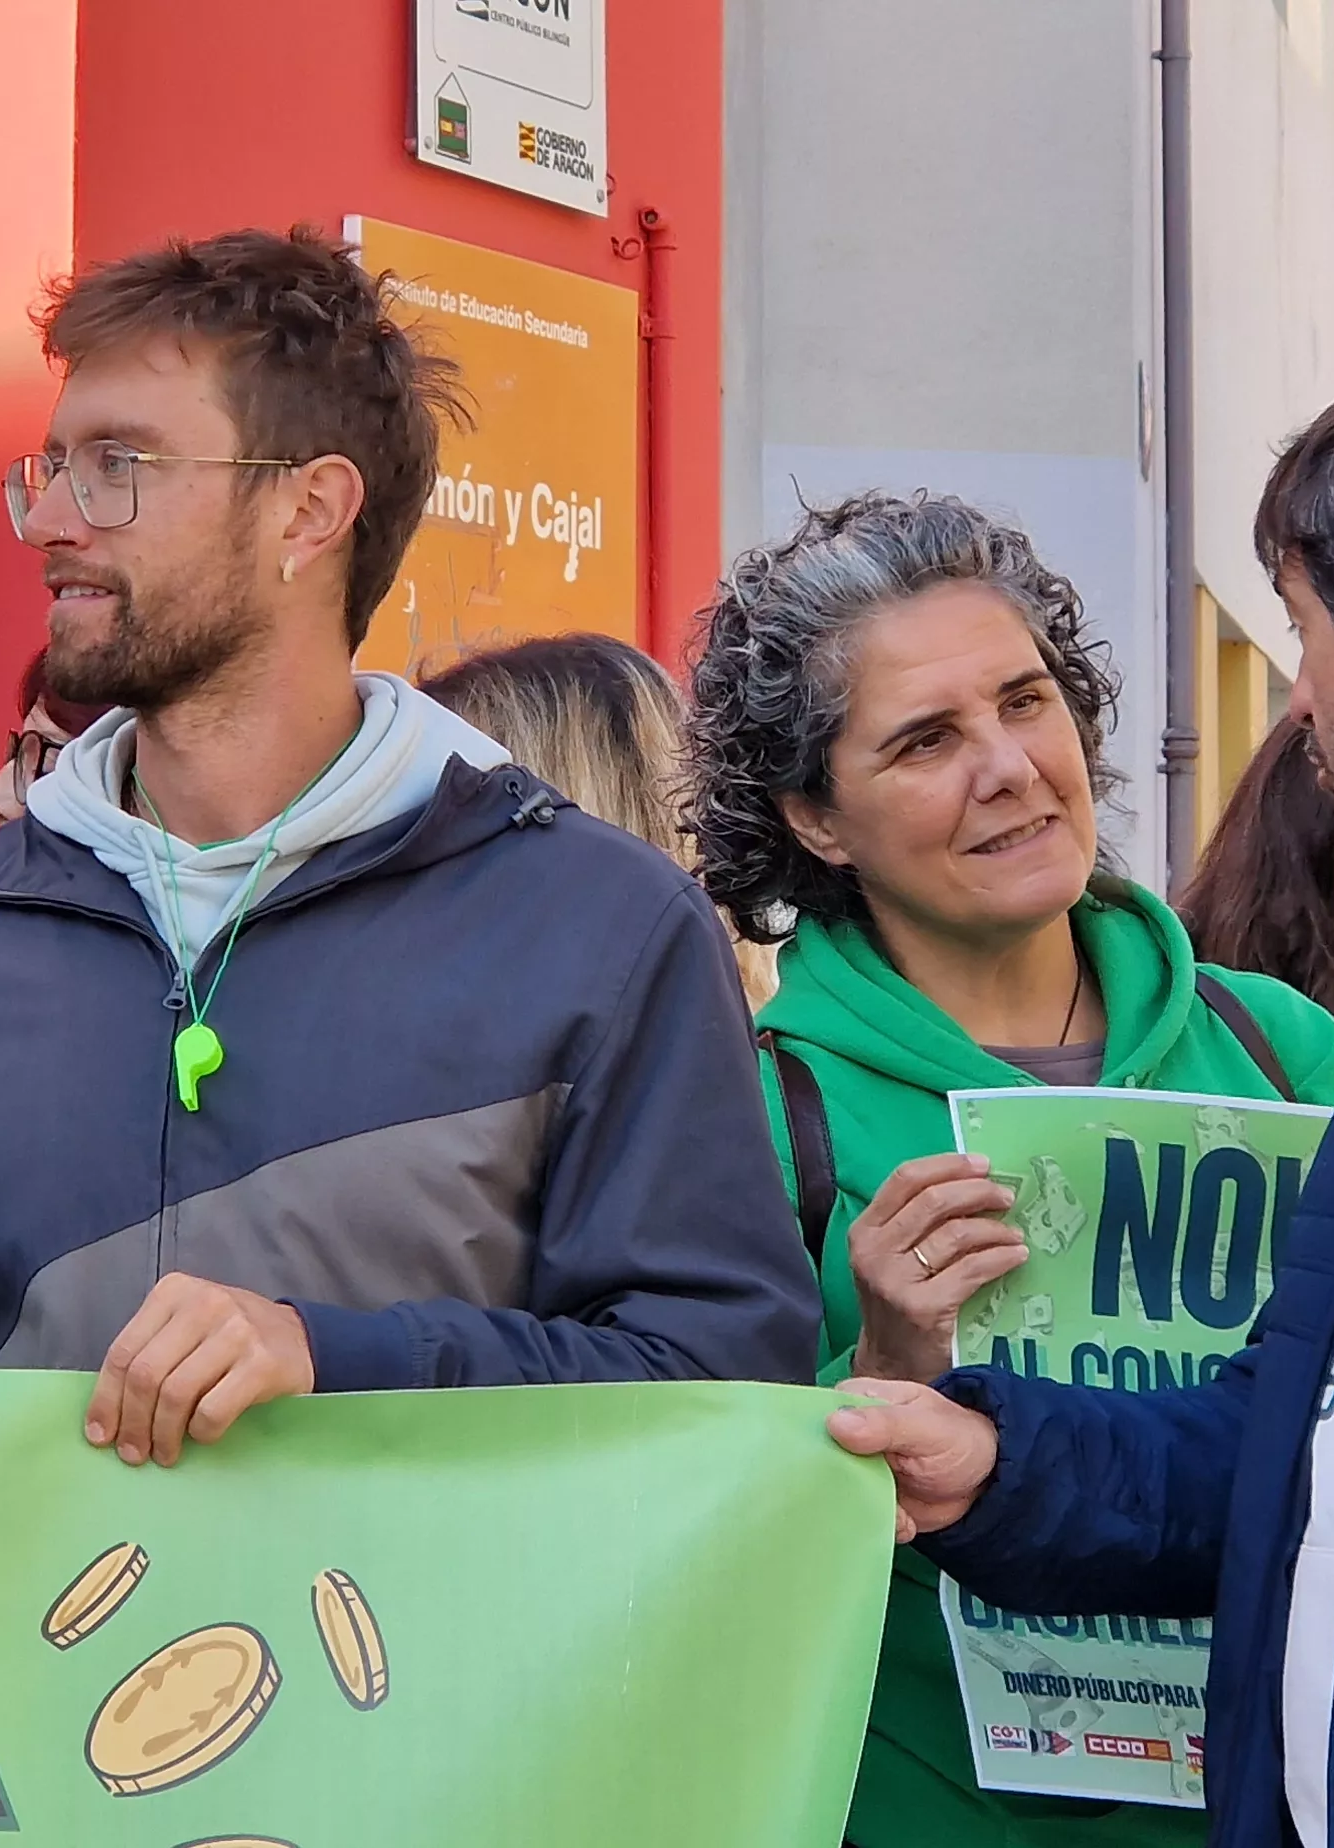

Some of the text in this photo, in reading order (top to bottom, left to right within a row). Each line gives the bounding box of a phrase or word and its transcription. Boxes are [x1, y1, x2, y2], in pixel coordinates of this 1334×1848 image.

[490, 10, 515, 28] CENTRO
[536, 126, 587, 160] GOBIERNO
[536, 146, 550, 169] DE
[440, 289, 456, 313] de
[459, 292, 523, 331] Educación
[524, 309, 589, 349] Secundaria
[422, 463, 602, 583] món y Cajal
[1002, 1670, 1071, 1698] DINERO
[1074, 1673, 1150, 1705] PÚBLICO
[1151, 1683, 1202, 1710] PARA
[1088, 1737, 1146, 1756] CCOO
